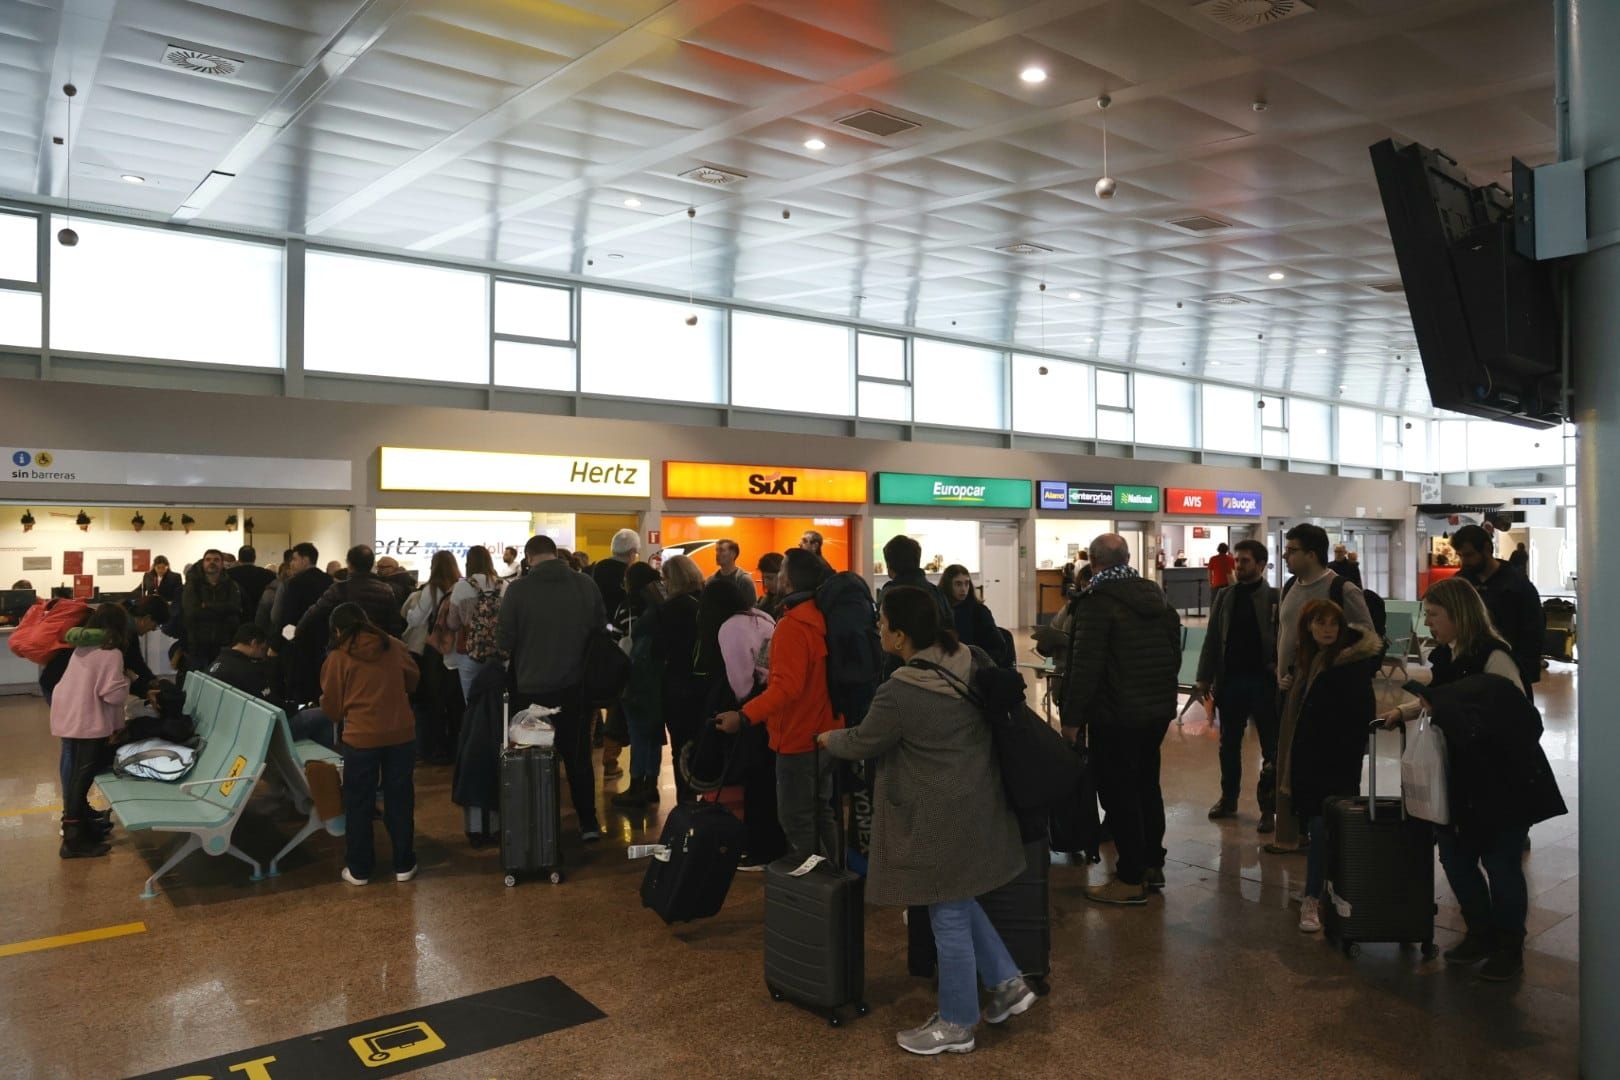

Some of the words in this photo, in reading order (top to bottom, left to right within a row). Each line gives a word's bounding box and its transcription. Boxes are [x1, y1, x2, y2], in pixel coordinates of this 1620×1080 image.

[12, 470, 29, 478] sin
[32, 470, 76, 480] barreras
[570, 461, 637, 484] Hertz
[933, 482, 985, 500] Europcar
[1070, 492, 1112, 503] enterprise
[1127, 493, 1153, 503] National
[1183, 496, 1202, 508] AVIS
[1232, 497, 1257, 512] Budget
[376, 537, 419, 555] ertz
